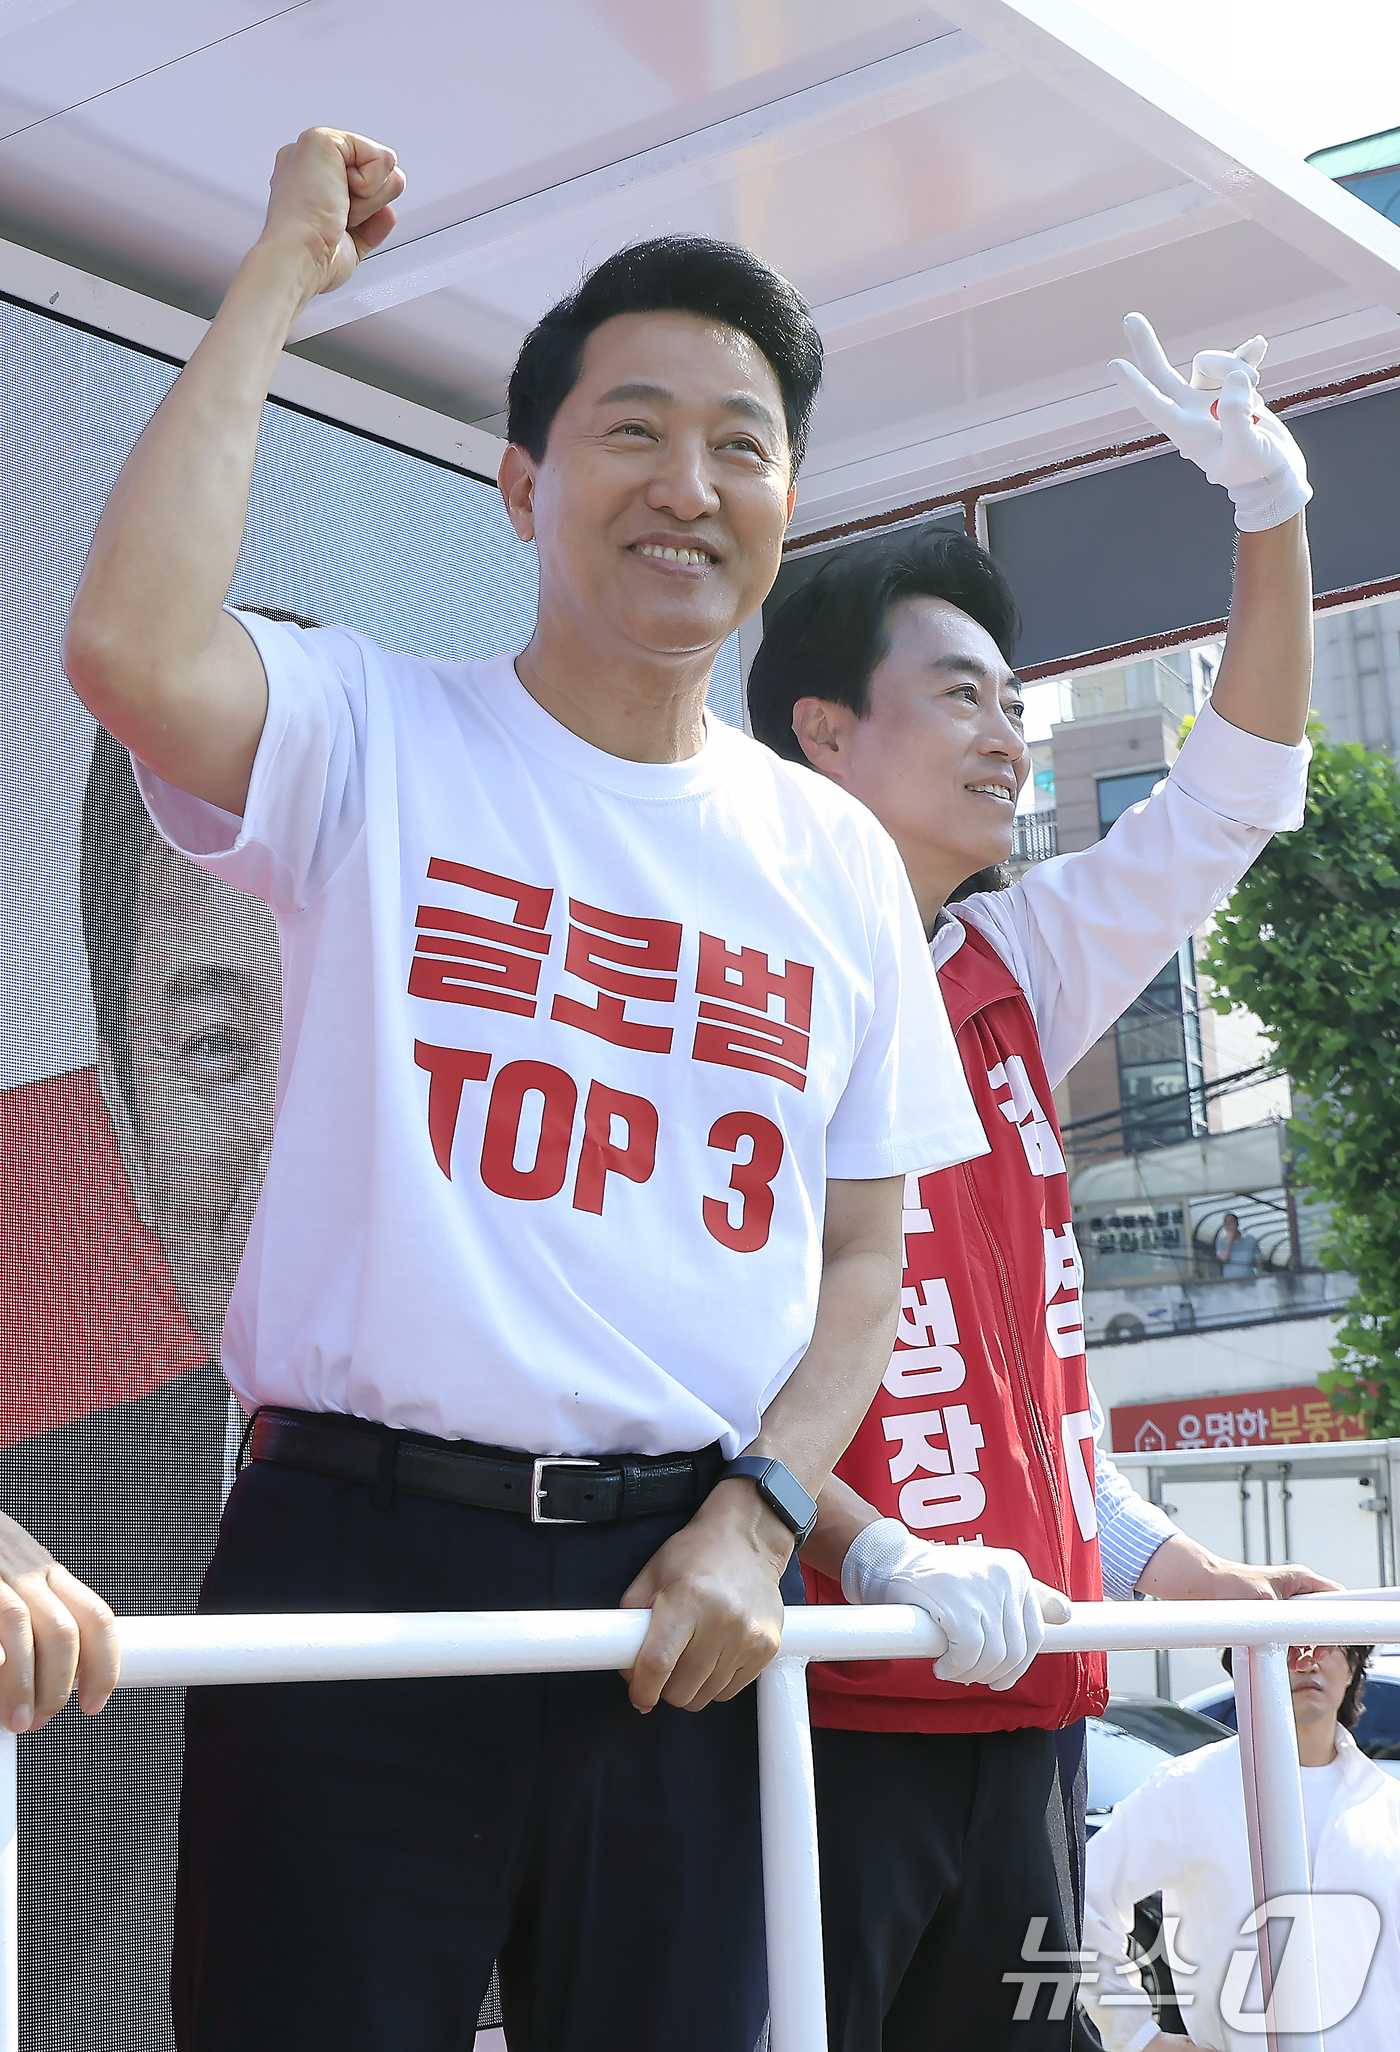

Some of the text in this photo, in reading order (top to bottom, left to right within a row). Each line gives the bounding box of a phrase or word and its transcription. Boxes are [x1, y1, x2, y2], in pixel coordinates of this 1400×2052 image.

[407, 856, 815, 1093] 글로벌
[413, 1038, 785, 1254] TOP 3
